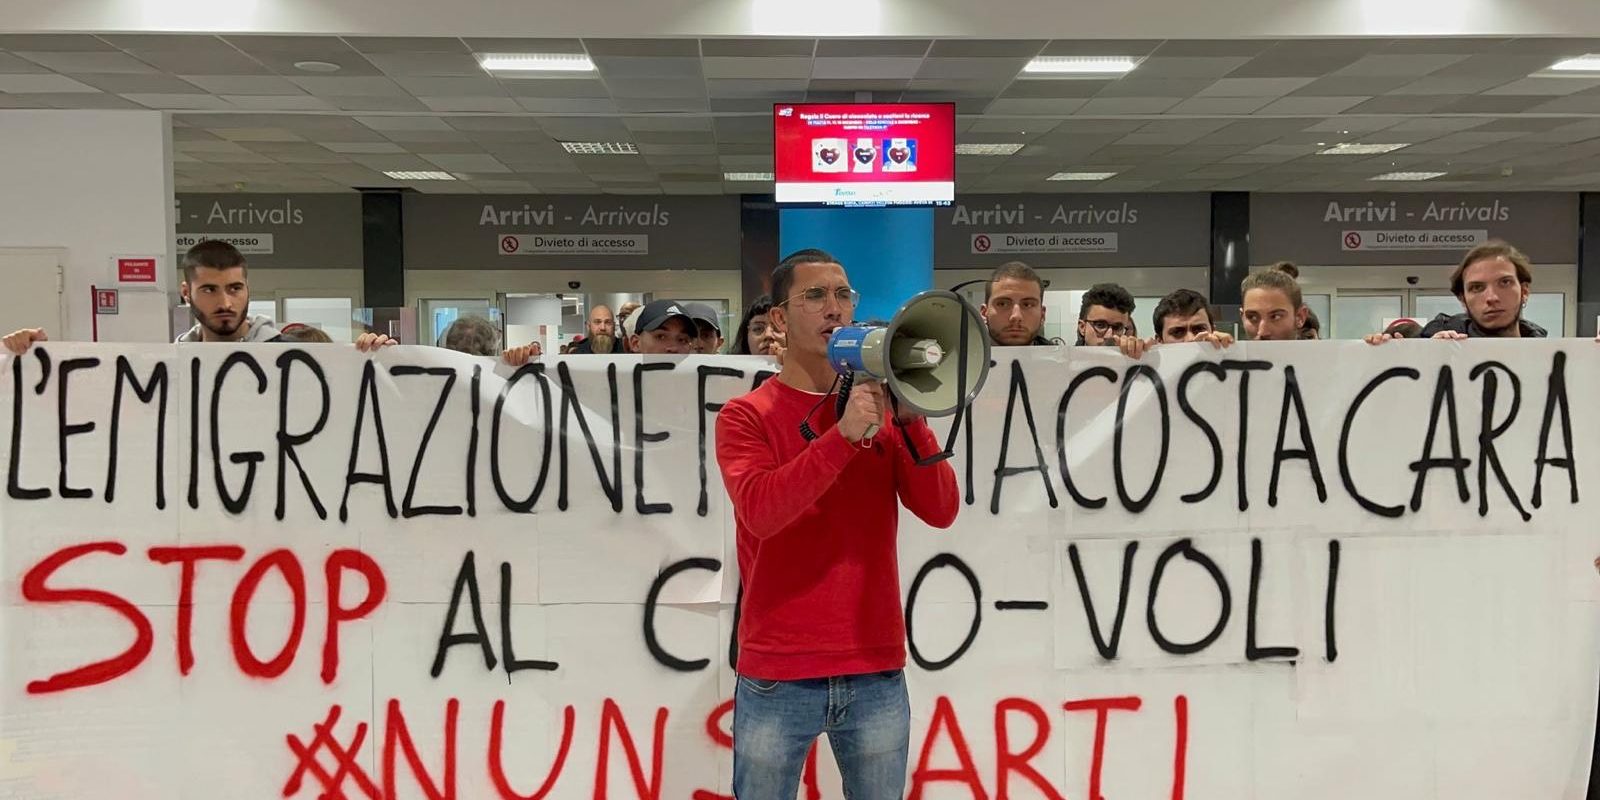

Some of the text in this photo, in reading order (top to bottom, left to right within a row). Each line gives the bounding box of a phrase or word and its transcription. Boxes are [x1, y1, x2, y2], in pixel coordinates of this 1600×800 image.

[207, 199, 304, 224] Arrivals
[479, 204, 555, 226] Arrivi
[580, 203, 671, 226] Arrivals
[951, 203, 1025, 225] Arrivi
[1050, 202, 1139, 225] Arrivals
[1323, 201, 1397, 222] Arrivi
[1422, 200, 1510, 221] Arrivals
[534, 237, 635, 248] Divieto di accesso
[1006, 235, 1105, 246] Divieto di accesso
[1376, 232, 1475, 243] Divieto di accesso
[1056, 358, 1327, 514] COSTA
[1337, 350, 1580, 521] CARA
[22, 541, 387, 694] STOP
[430, 550, 559, 680] AL
